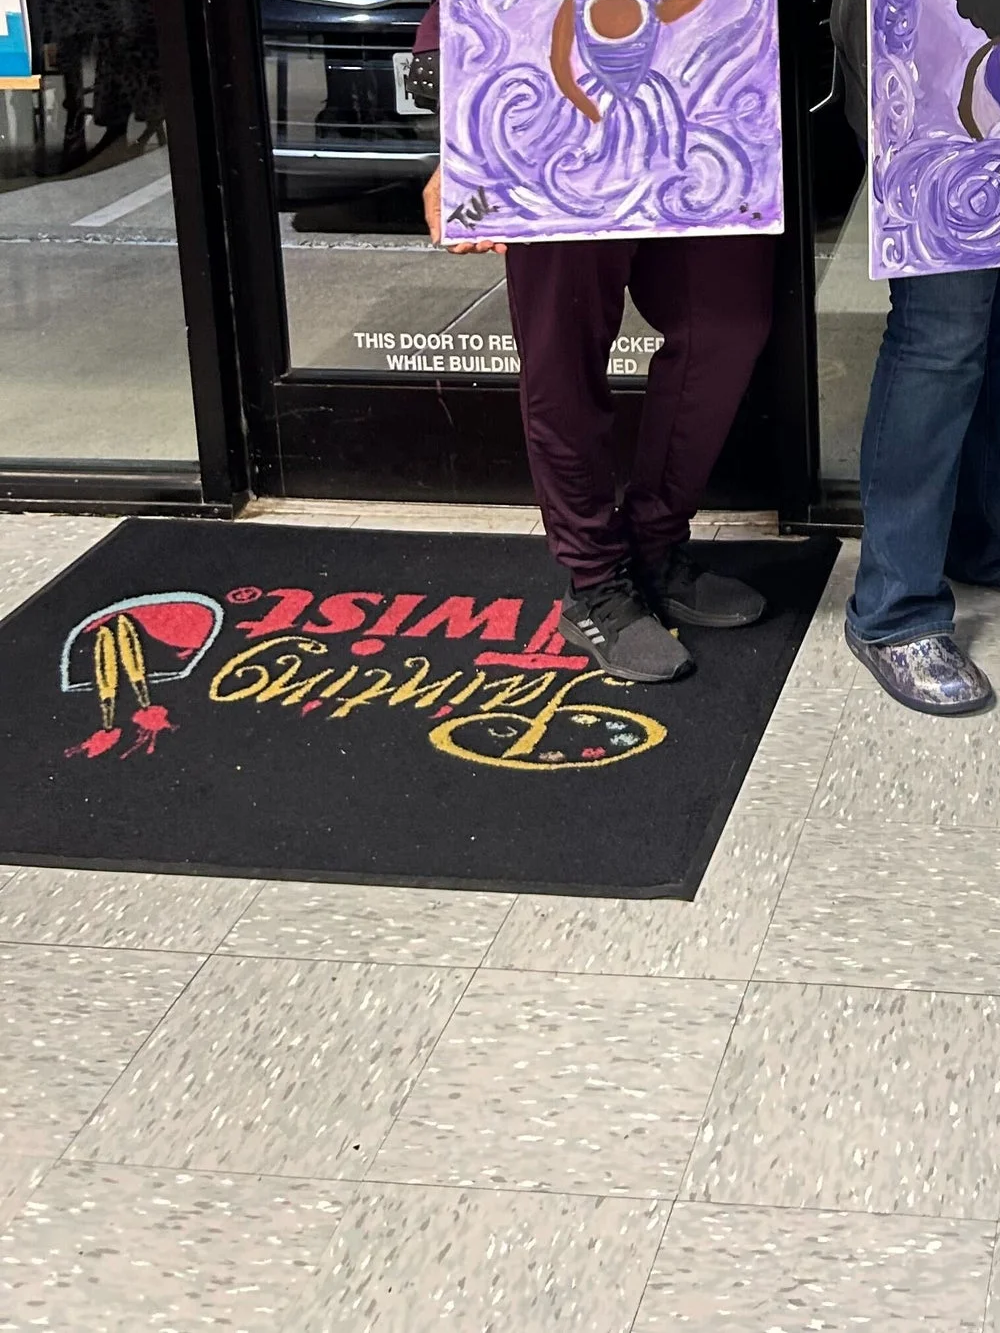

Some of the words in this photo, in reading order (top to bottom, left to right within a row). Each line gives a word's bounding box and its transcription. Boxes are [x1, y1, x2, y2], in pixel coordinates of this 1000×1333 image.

[354, 332, 395, 349] THIS
[399, 333, 453, 351] DOOR
[458, 334, 484, 351] TO
[387, 354, 445, 371] WHILE
[449, 356, 521, 374] BUILDIN
